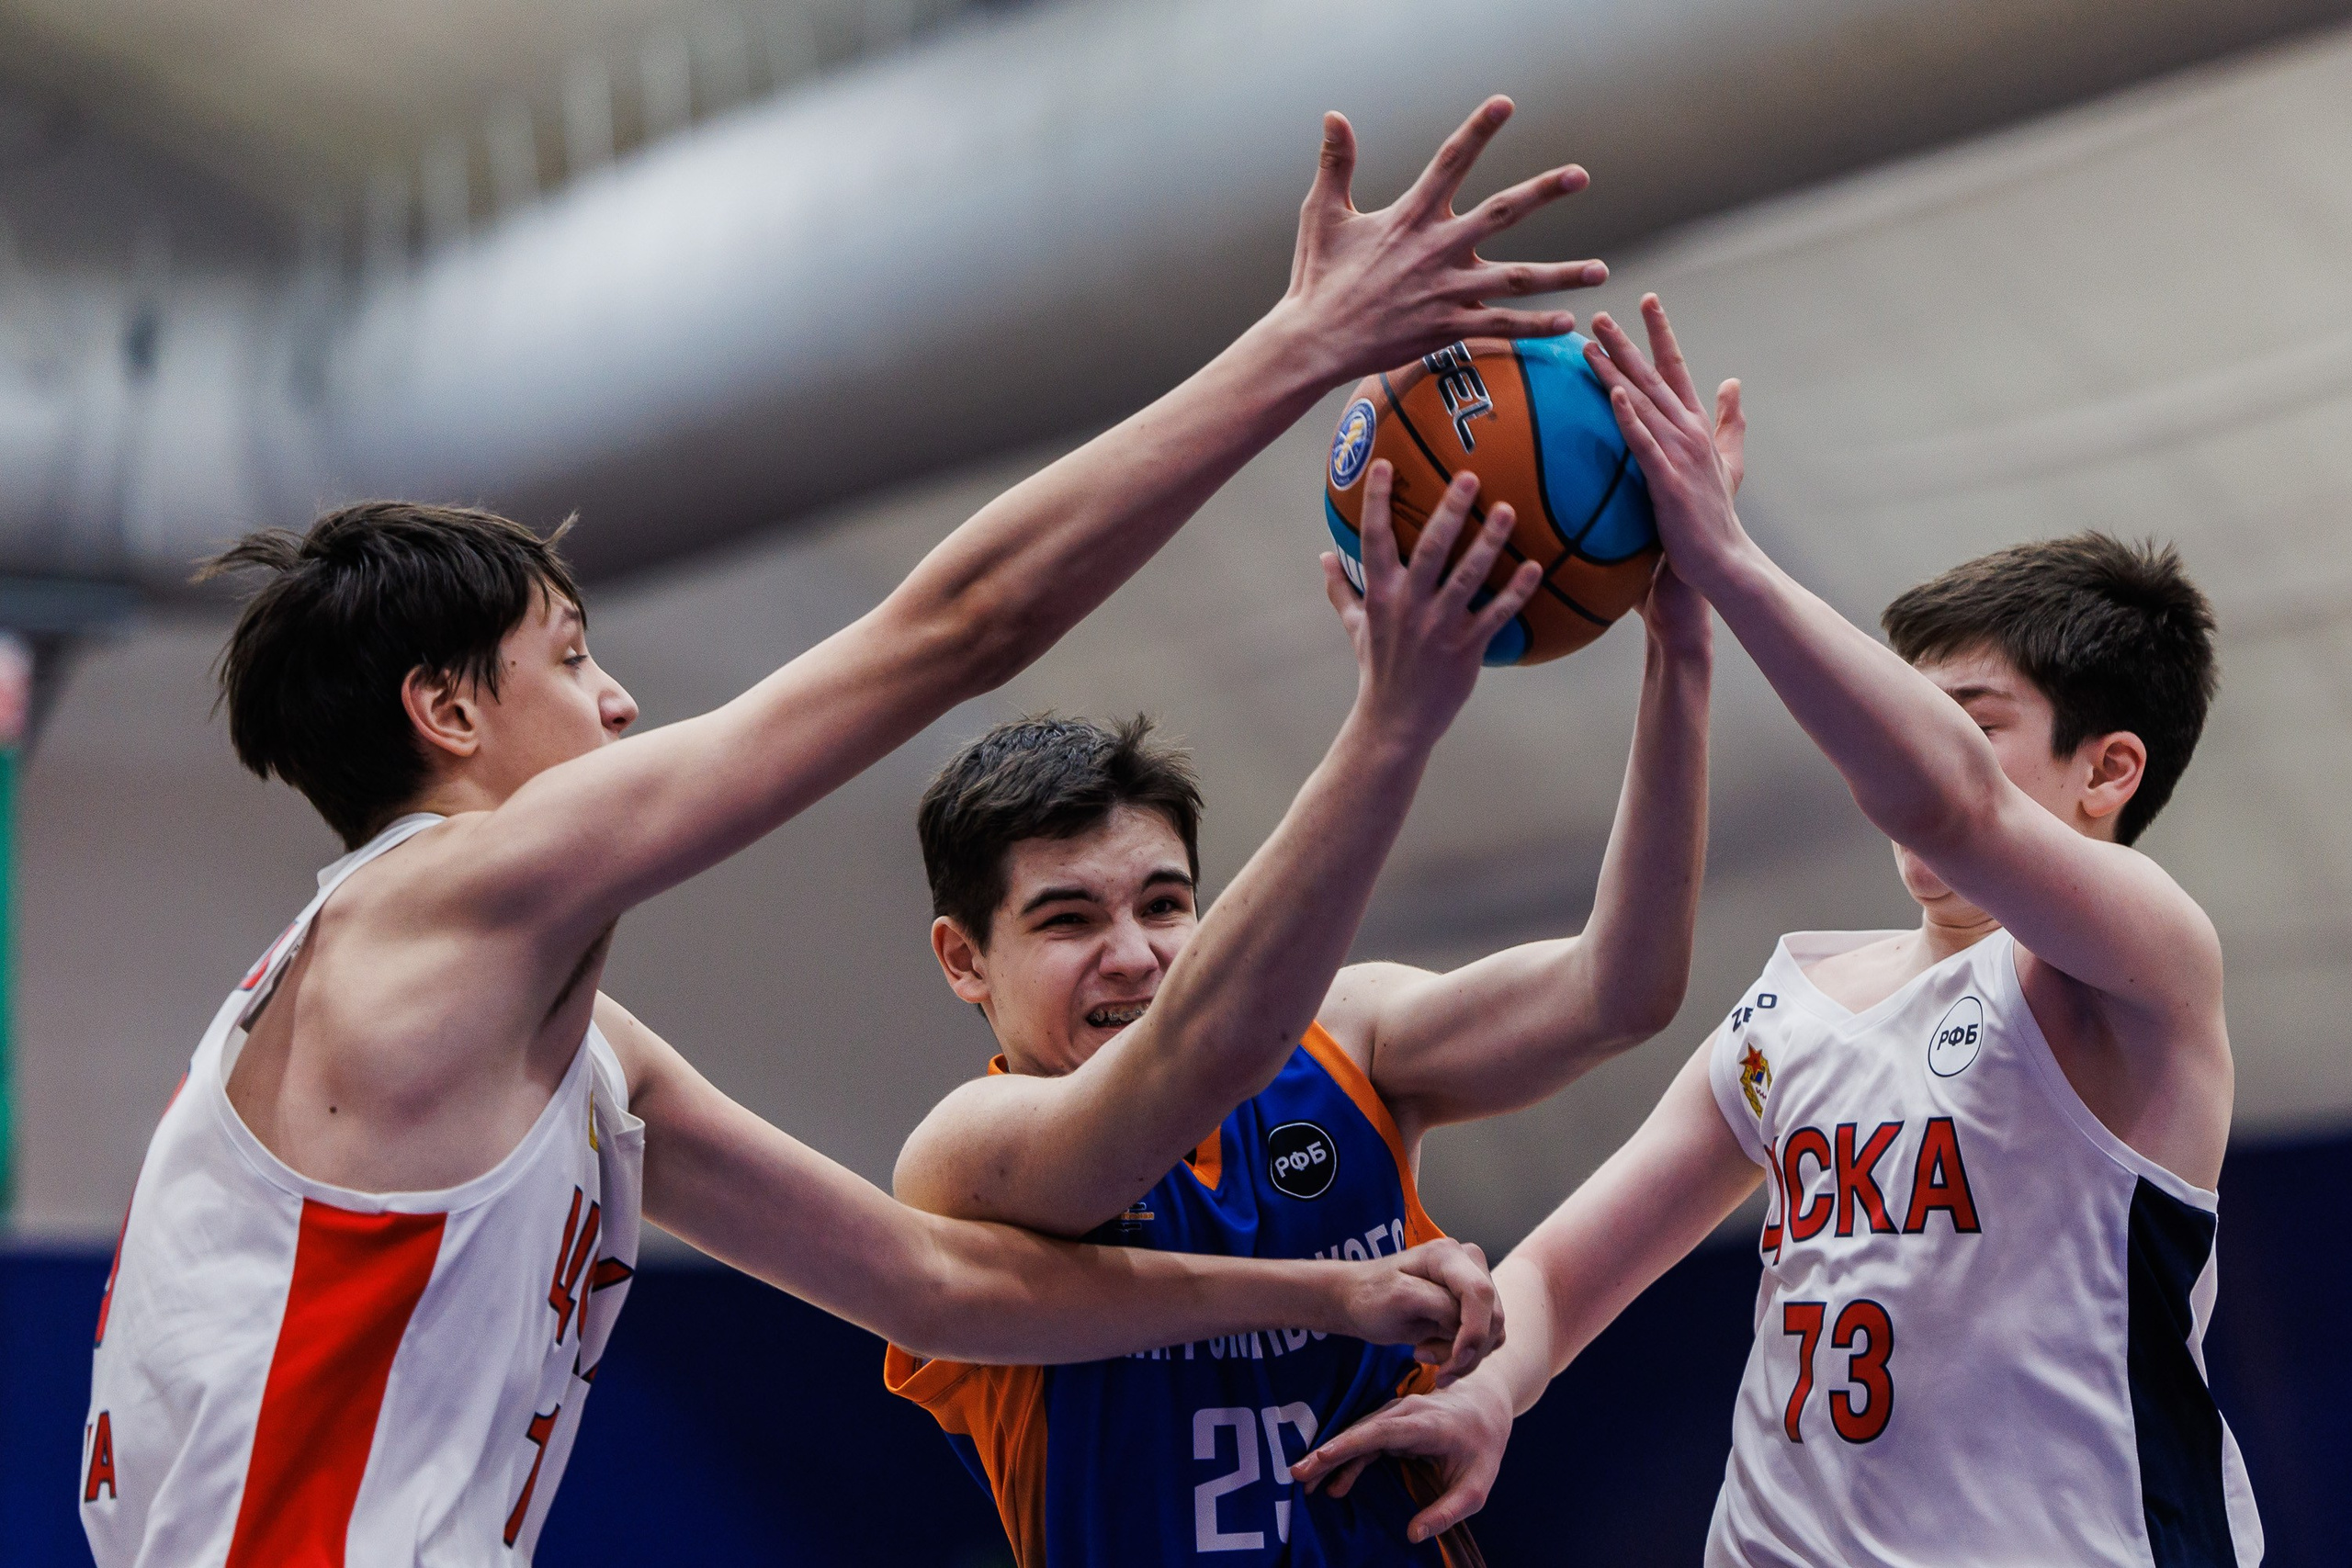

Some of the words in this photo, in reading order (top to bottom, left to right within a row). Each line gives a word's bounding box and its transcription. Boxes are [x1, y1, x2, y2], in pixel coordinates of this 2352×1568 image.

[1937, 1023, 1978, 1051] РФБ
[1274, 1141, 1327, 1179] РФБ
[1782, 1298, 1895, 1445] 73
